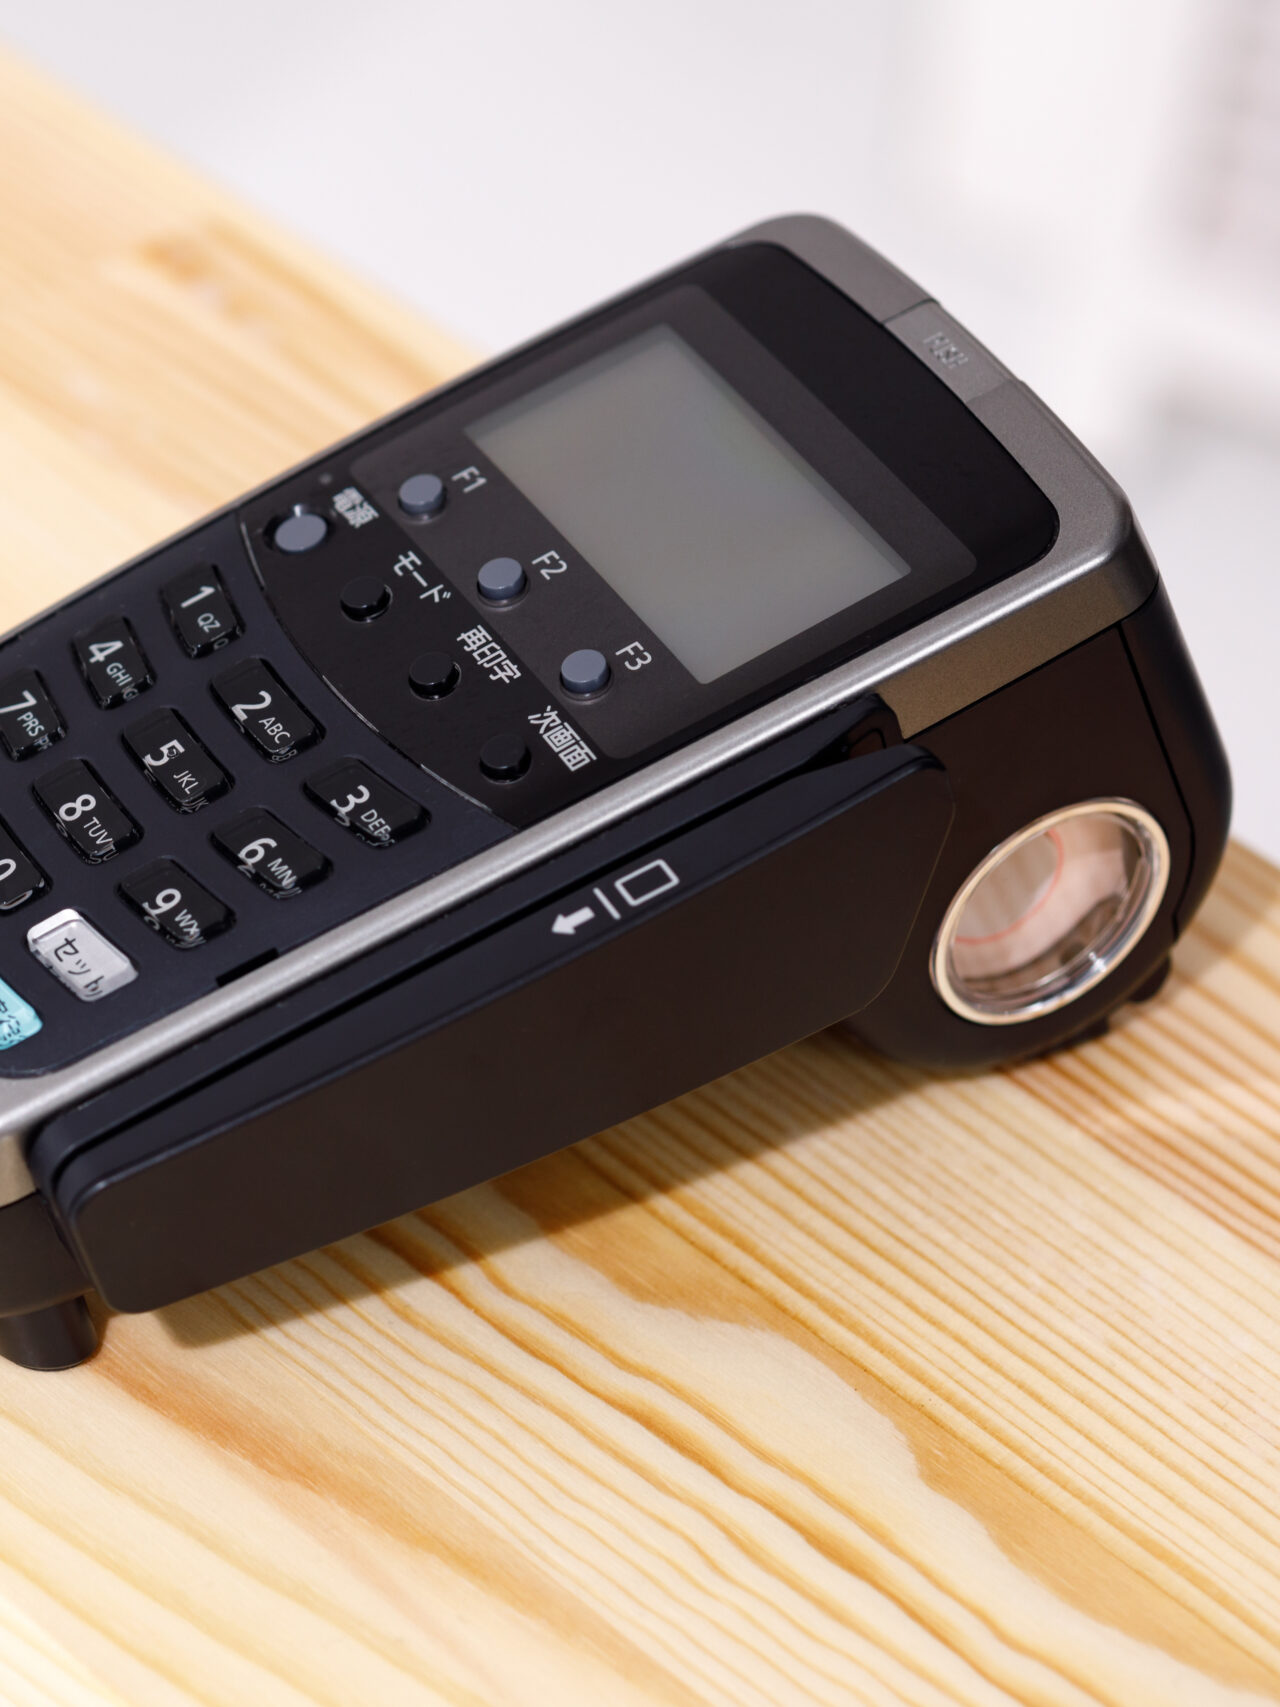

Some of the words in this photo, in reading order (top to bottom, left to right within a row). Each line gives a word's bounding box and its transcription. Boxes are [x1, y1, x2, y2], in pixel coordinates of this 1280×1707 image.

[451, 465, 488, 494] F1
[332, 486, 380, 528] 電源
[393, 550, 452, 604] モード
[531, 550, 568, 581] F2
[181, 585, 216, 609] 1
[197, 612, 221, 633] QZ
[88, 640, 124, 664] 4
[456, 624, 522, 685] 再印字
[615, 641, 653, 671] F3
[17, 711, 46, 738] PRS
[231, 690, 272, 722] 2
[258, 716, 291, 744] ABC
[528, 705, 597, 772] 次画面
[144, 739, 186, 767] 5
[173, 770, 200, 795] JKL
[329, 784, 371, 814] 3
[58, 793, 97, 822] 8
[83, 816, 114, 845] TUV
[237, 837, 278, 864] 6
[142, 887, 182, 915] 9
[54, 937, 105, 993] セット
